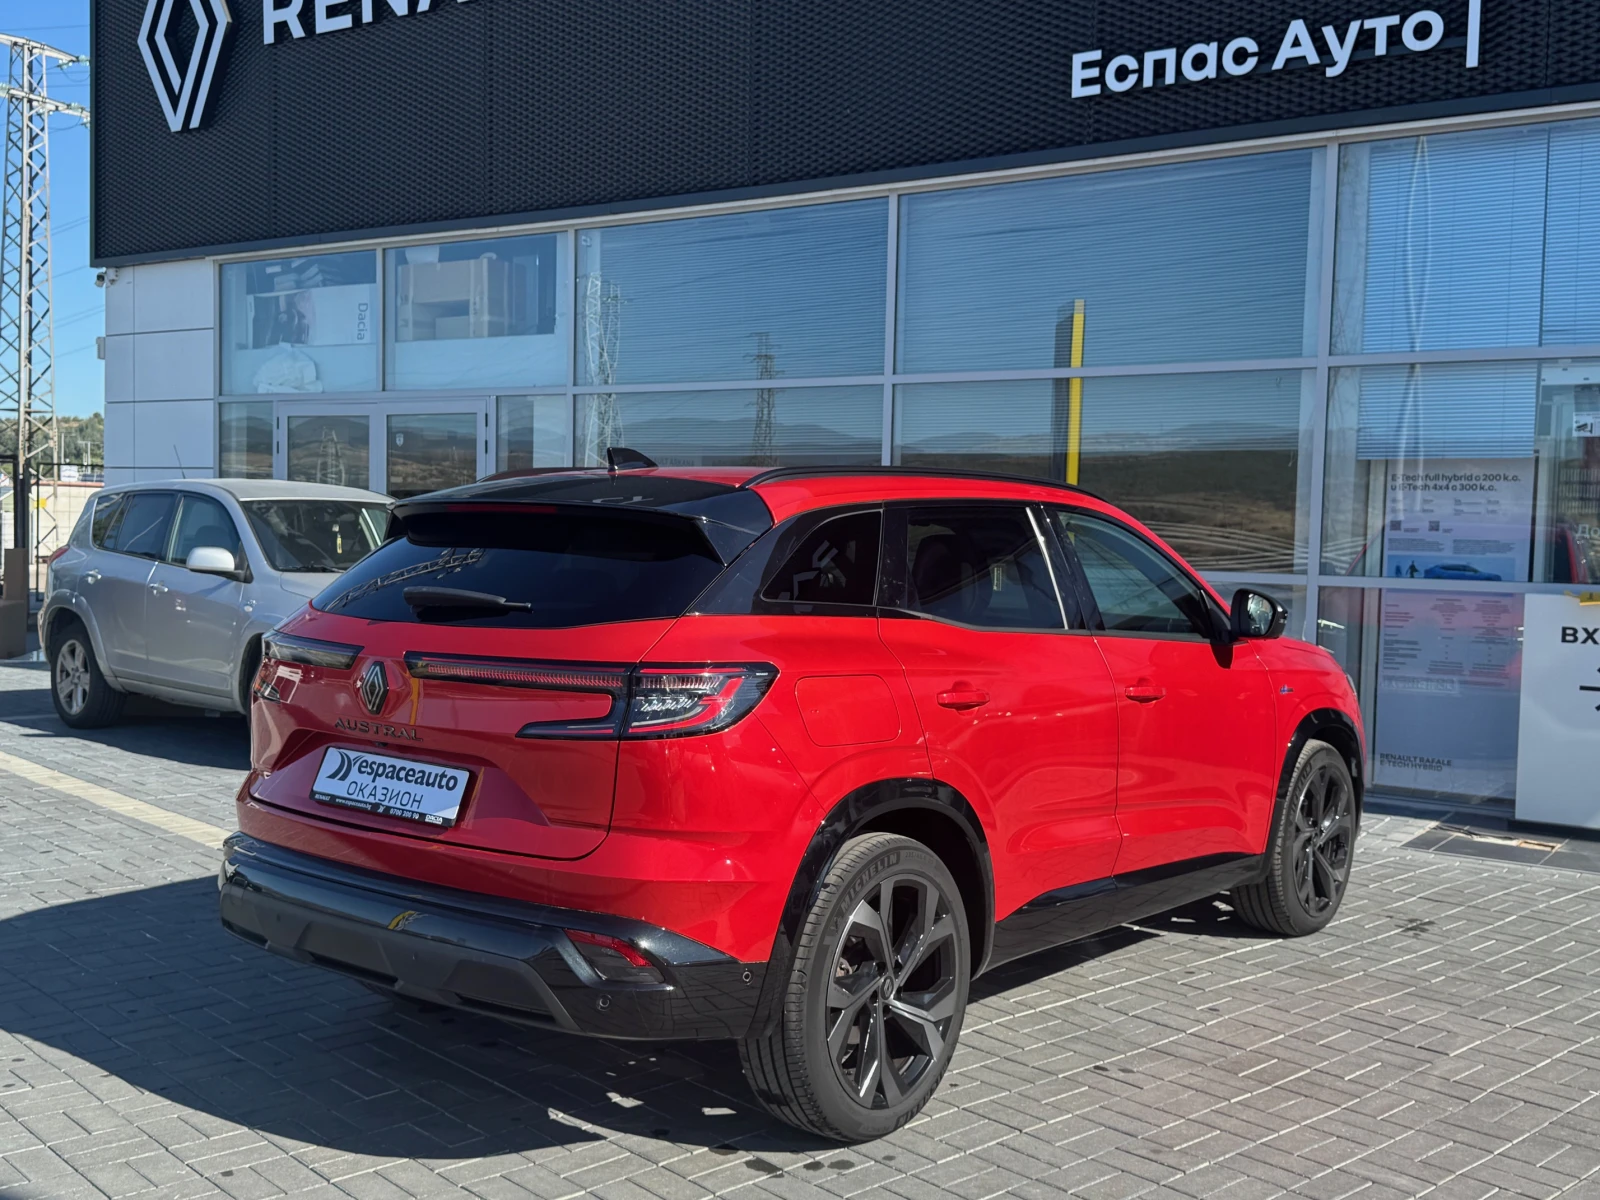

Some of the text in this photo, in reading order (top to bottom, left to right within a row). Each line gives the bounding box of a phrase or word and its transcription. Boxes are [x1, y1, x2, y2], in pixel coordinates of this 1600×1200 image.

[1071, 10, 1444, 99] Еспас Ауто
[357, 302, 369, 341] Dacia
[1424, 473, 1440, 482] full
[1442, 473, 1473, 484] hybrid
[1482, 473, 1502, 482] 200
[1431, 483, 1450, 491] 4x4
[1459, 483, 1478, 492] 300
[335, 718, 424, 741] AUSTRAL
[1380, 753, 1452, 767] RENAULT RAFALE
[1380, 759, 1443, 772] E-TECH HYBRID
[357, 758, 459, 791] espaceauto
[346, 781, 424, 809] ОКАЗИОН
[840, 852, 899, 911] MICHELIN
